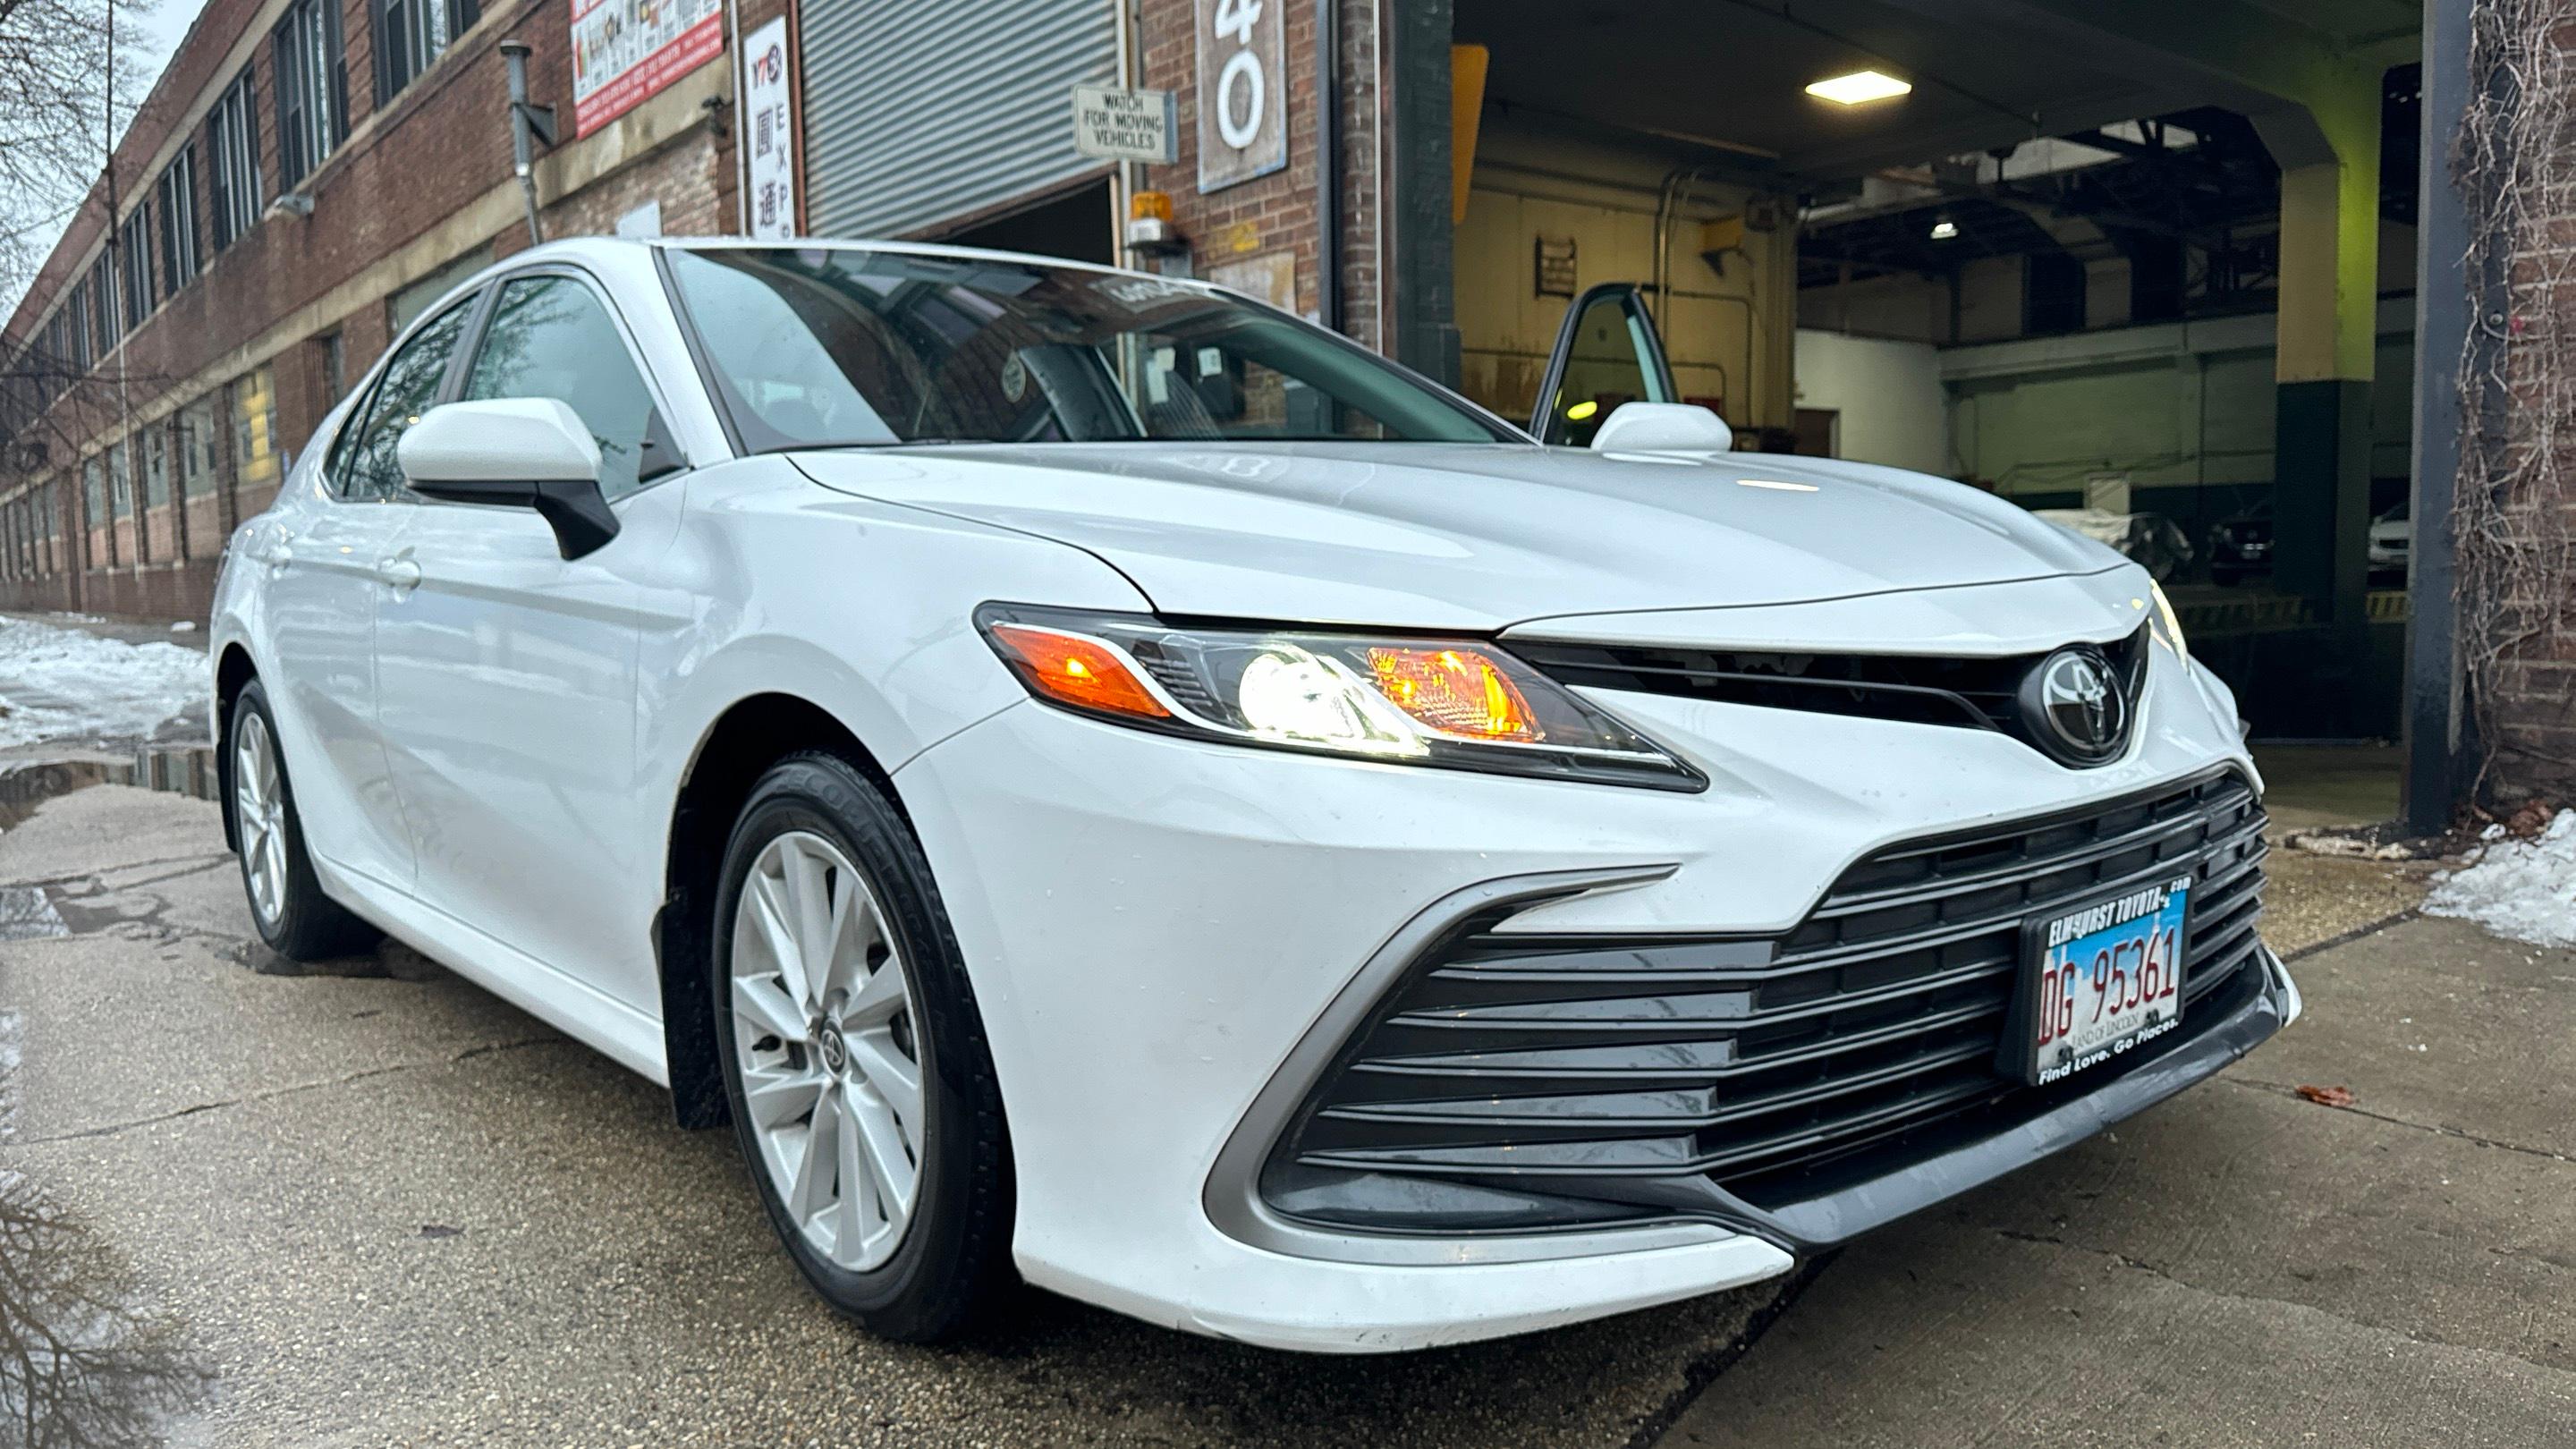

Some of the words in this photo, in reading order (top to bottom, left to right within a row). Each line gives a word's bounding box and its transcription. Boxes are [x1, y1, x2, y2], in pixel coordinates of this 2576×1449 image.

[1102, 92, 1144, 111] WATCH
[1083, 108, 1109, 126] FOR
[1114, 113, 1164, 133] MOVING
[1093, 129, 1156, 151] VEHICLES
[2115, 886, 2162, 924] TOYOTA
[2038, 962, 2075, 1047] DG
[2091, 927, 2175, 1023] 95361
[2038, 1061, 2072, 1086] Find
[2073, 1049, 2111, 1072] Love.
[2114, 1038, 2134, 1055] Go
[2136, 1018, 2179, 1045] Places.
